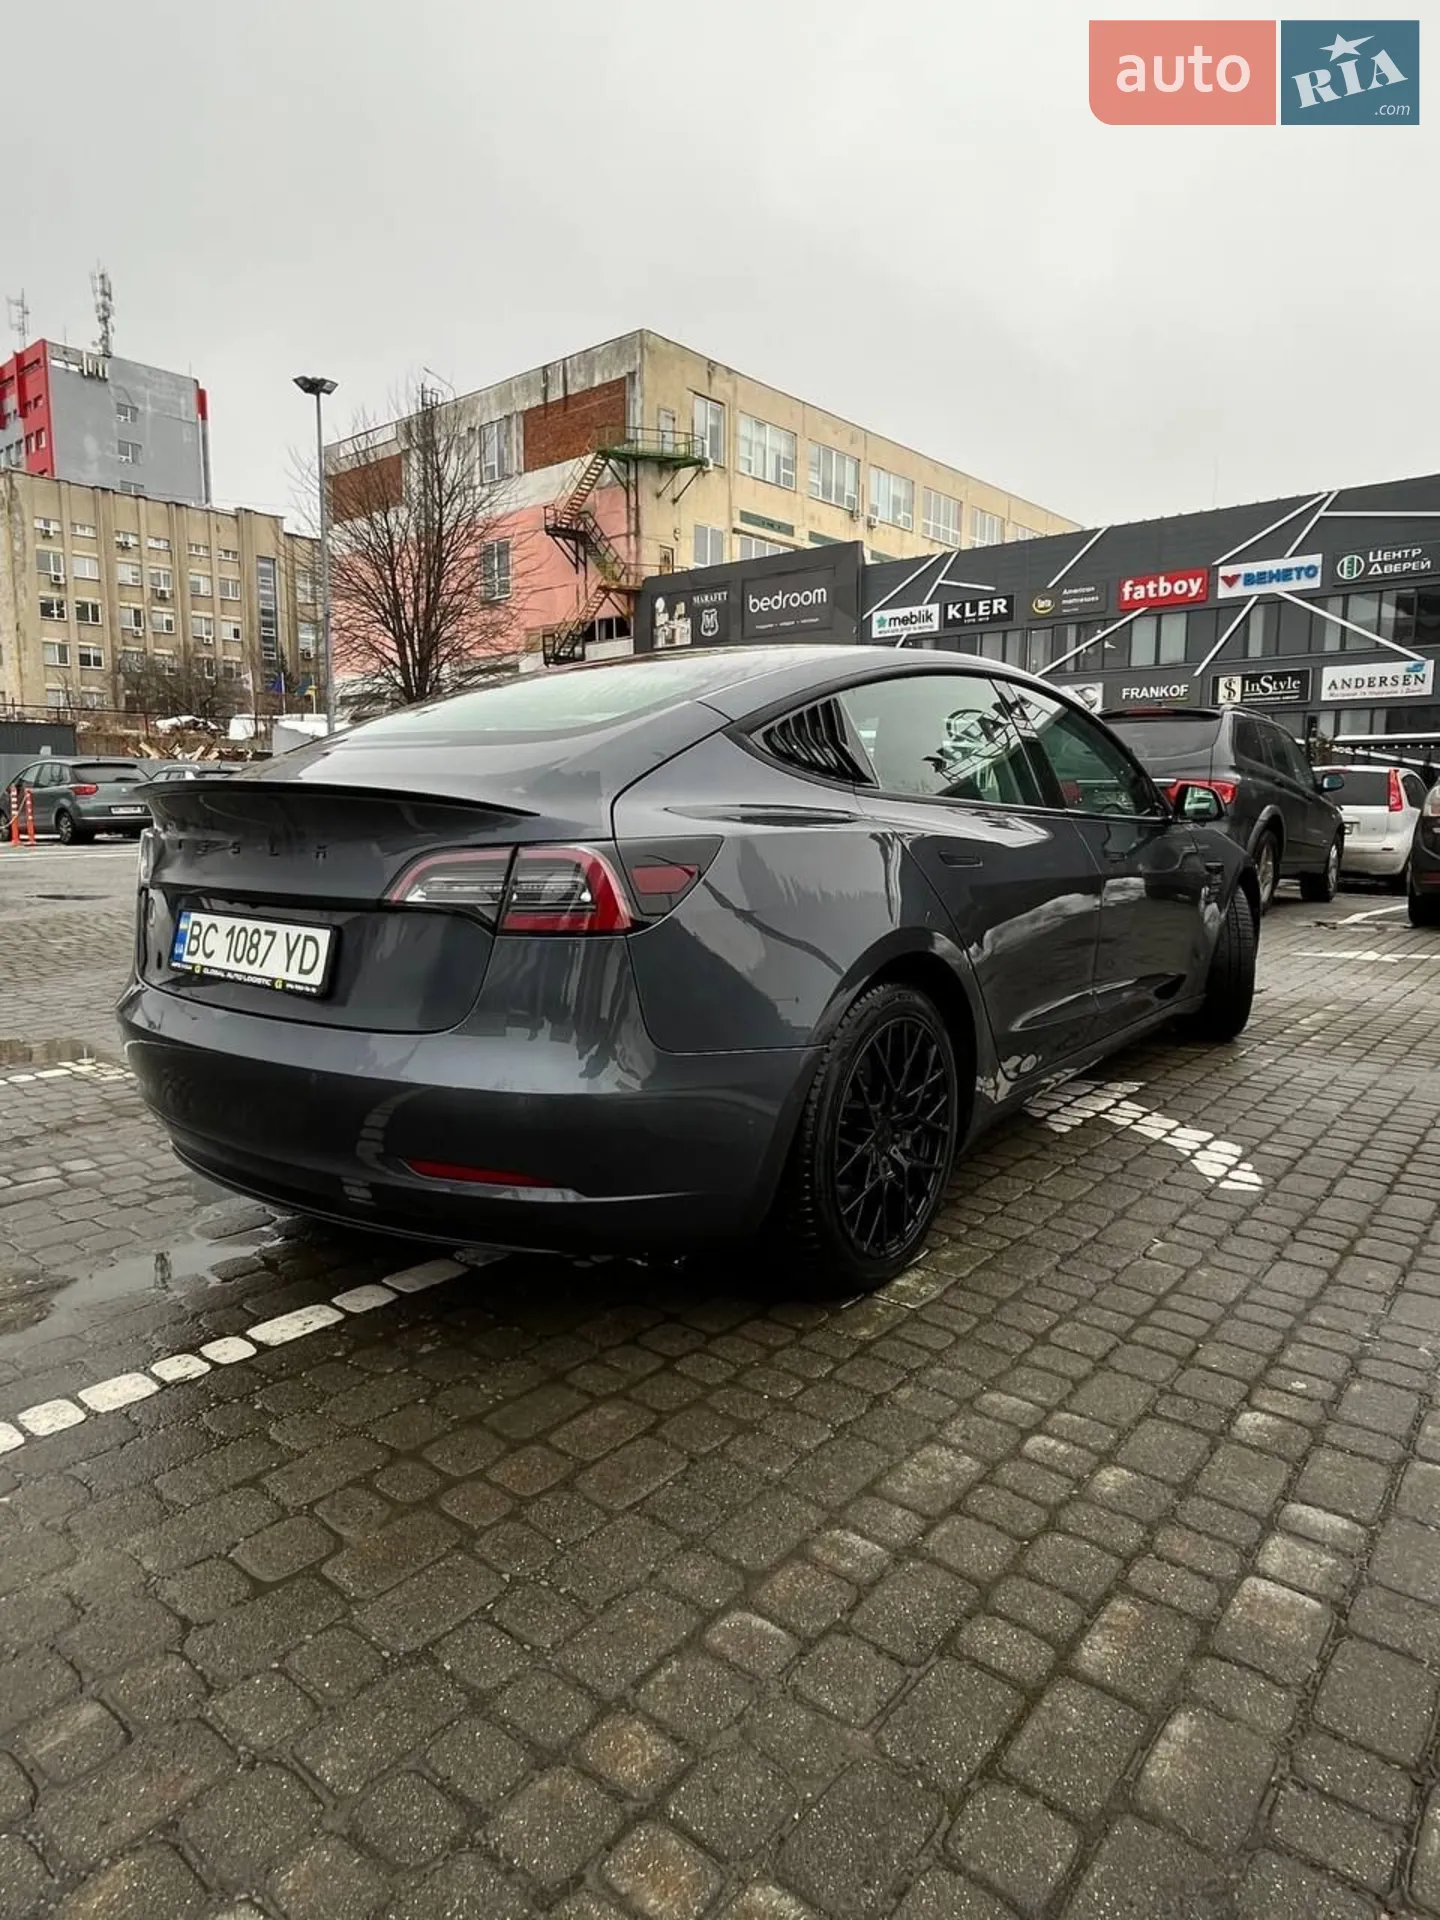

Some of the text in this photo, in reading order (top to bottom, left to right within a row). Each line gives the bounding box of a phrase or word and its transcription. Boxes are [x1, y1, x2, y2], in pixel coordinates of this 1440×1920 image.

[1121, 576, 1202, 601] fatboy
[748, 587, 827, 612] bedroom
[947, 598, 1009, 620] KLER
[888, 610, 934, 628] meblik
[1121, 684, 1189, 700] FRANKOF
[1244, 675, 1302, 696] InStyle
[1327, 672, 1426, 691] ANDERSEN
[186, 920, 321, 976] BC 1087 YD
